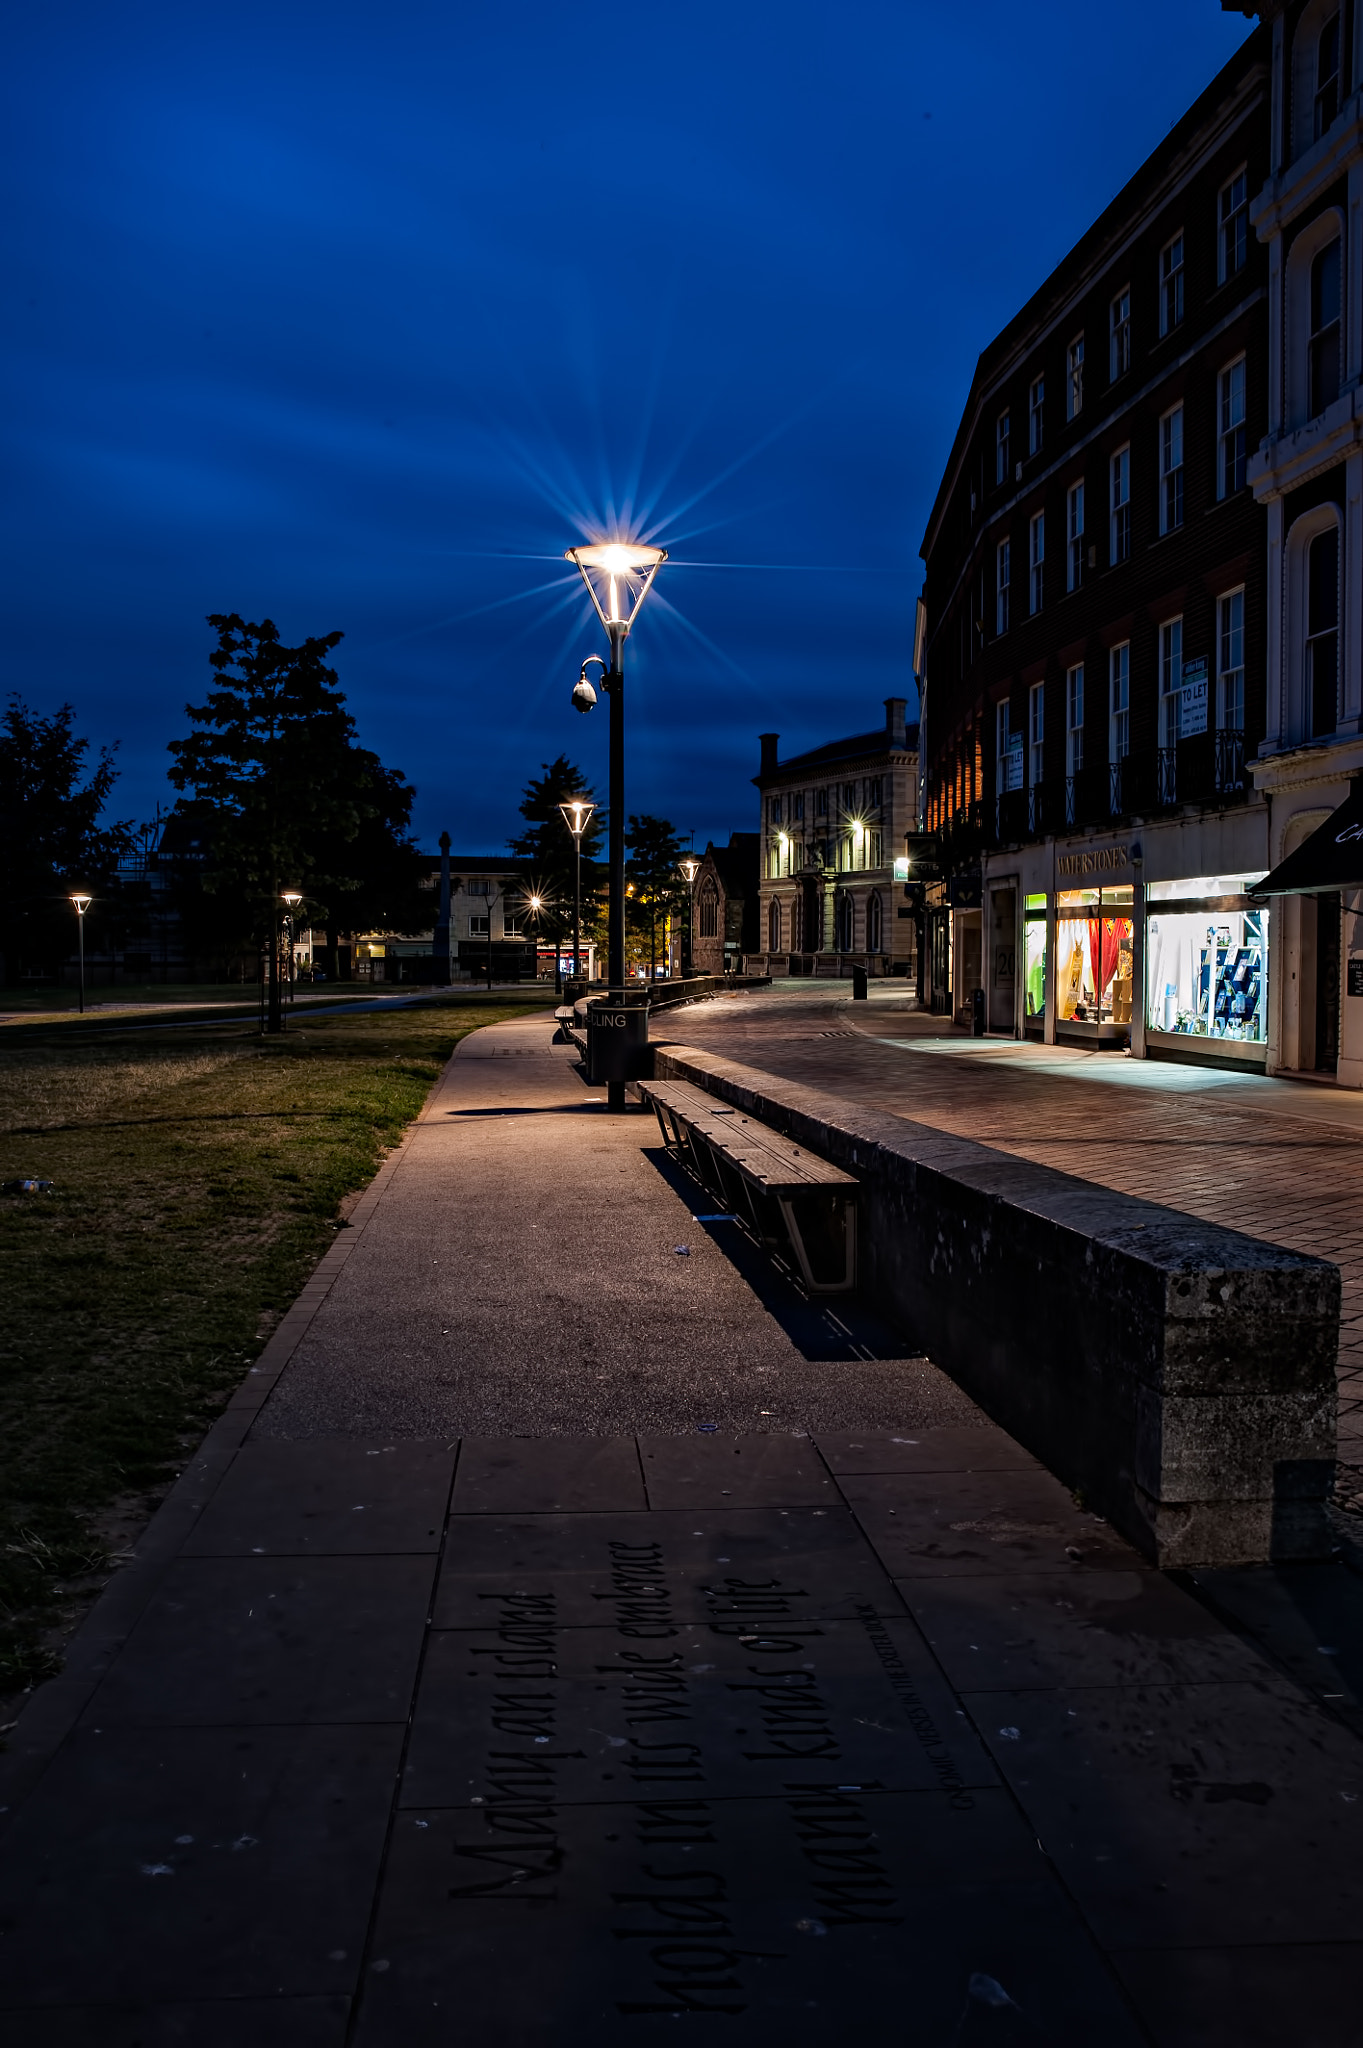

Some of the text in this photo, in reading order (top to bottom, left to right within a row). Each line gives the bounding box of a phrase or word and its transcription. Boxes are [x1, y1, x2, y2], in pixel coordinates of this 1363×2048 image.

[1182, 683, 1207, 702] TO LET
[1057, 845, 1127, 875] WATERSTONE'S
[448, 1593, 588, 1899] Many an island
[593, 1541, 788, 2015] holds in its wide embrace
[700, 1578, 904, 1926] many kinds of life
[856, 1603, 976, 1811] GNOMIC VERSES IN THE EXETER BOOK
